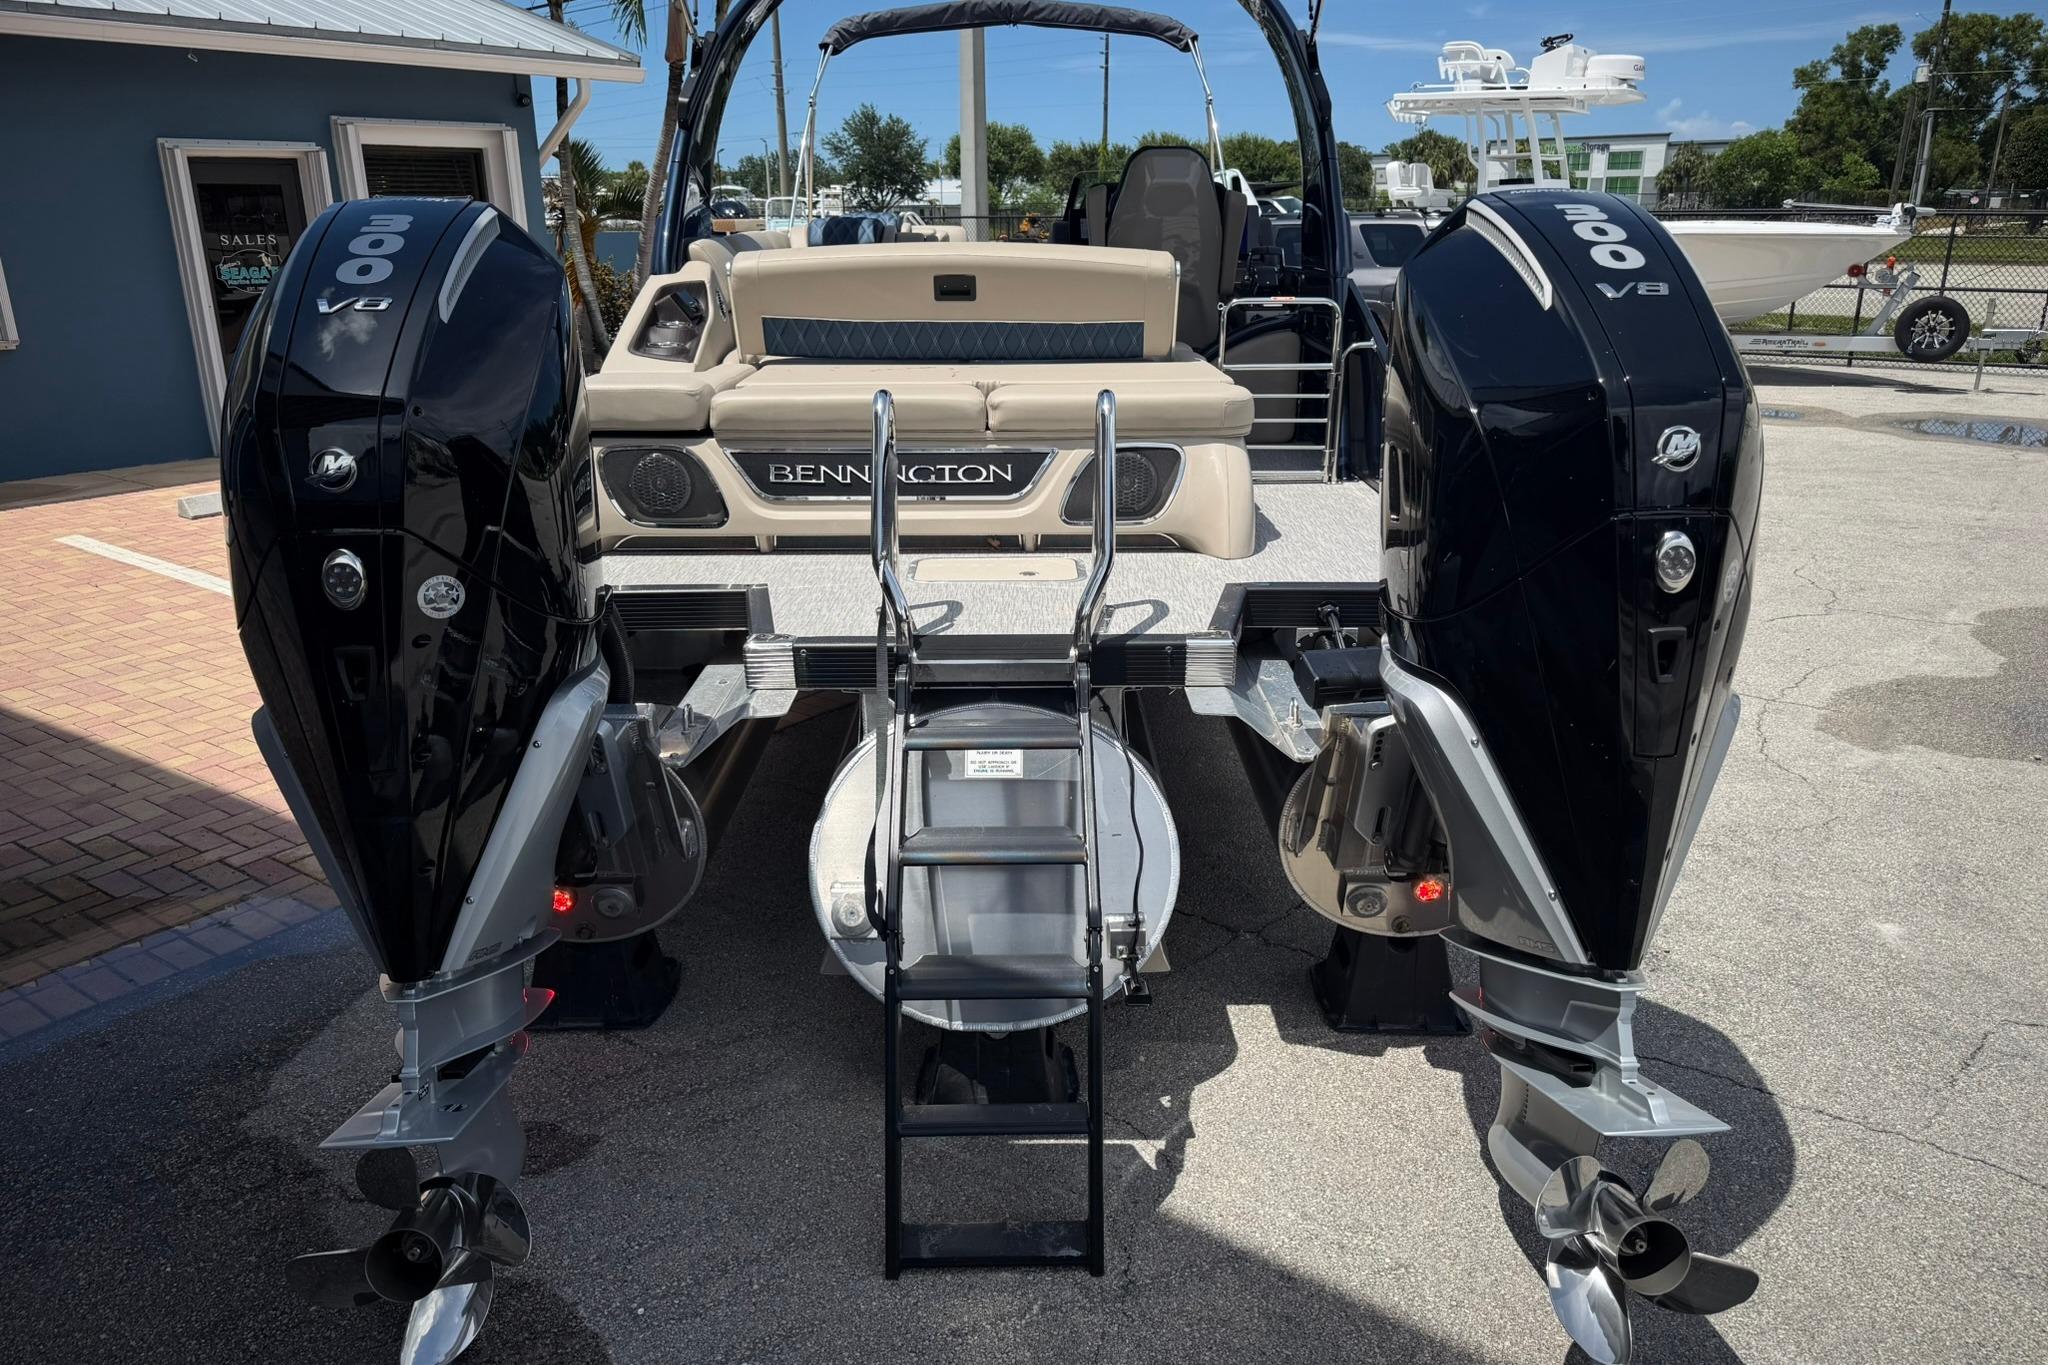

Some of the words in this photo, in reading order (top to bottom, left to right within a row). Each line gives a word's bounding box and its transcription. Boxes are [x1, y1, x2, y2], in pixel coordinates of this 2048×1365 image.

[220, 234, 277, 246] SALES
[1553, 203, 1646, 270] 300
[335, 214, 414, 285] 300
[1594, 281, 1670, 299] V8
[316, 296, 393, 314] V8
[769, 464, 1013, 484] BENNGTON
